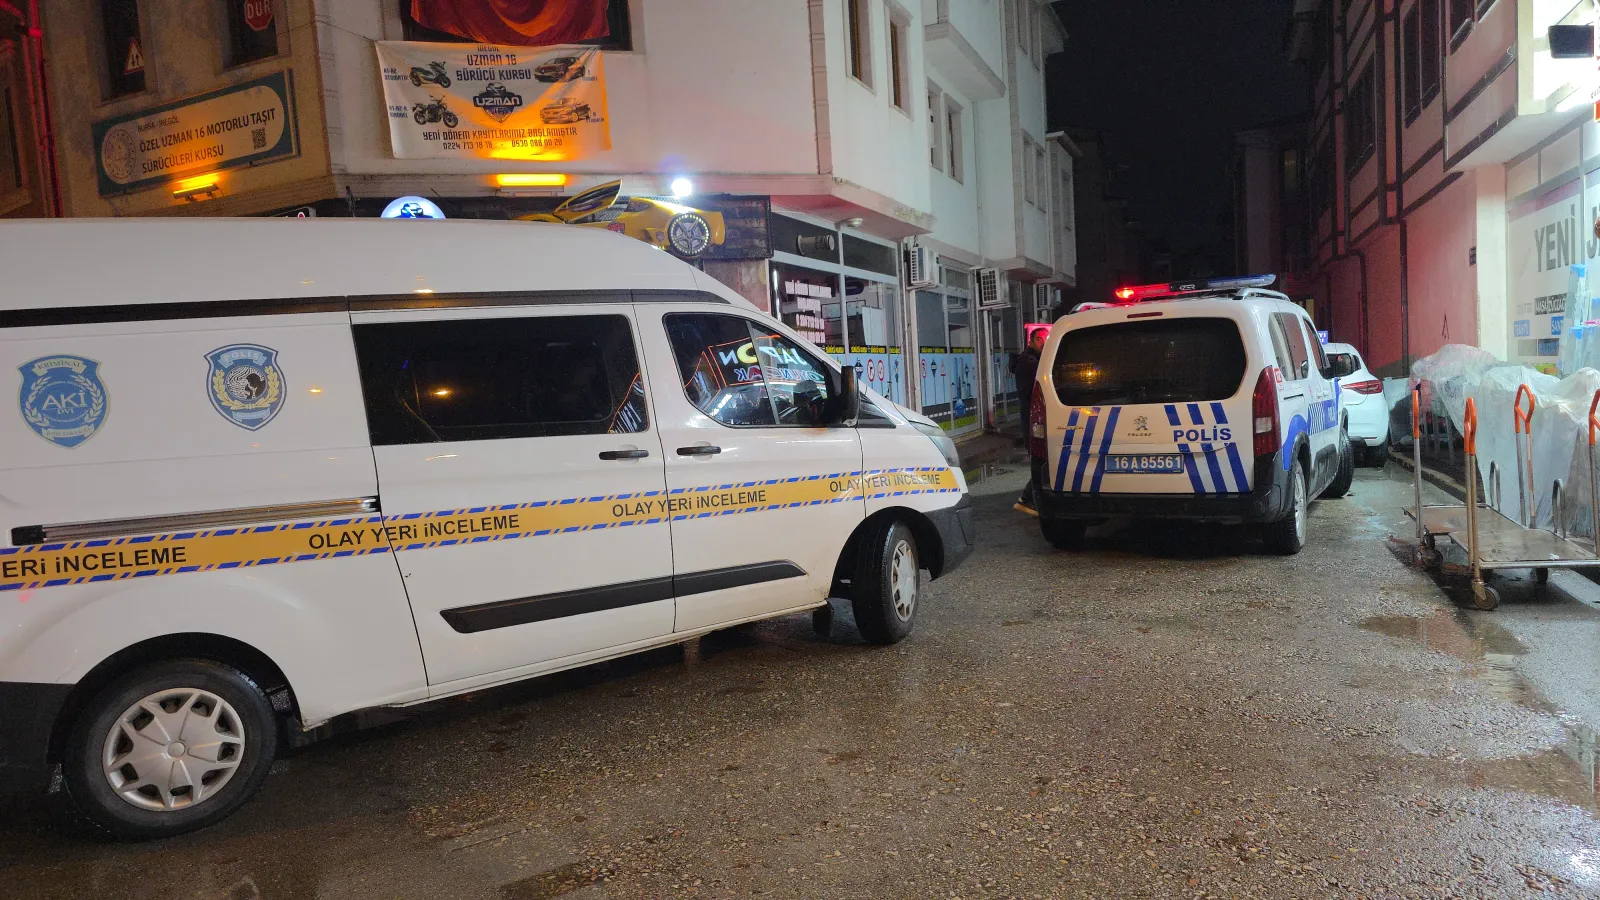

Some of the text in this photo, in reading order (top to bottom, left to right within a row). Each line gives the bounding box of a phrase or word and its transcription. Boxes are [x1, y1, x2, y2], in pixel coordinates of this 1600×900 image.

[246, 1, 271, 19] DUR
[466, 54, 517, 66] UZMAN 16
[456, 68, 531, 81] SÜRÜCÜ KURSU
[475, 96, 520, 106] UZMAN
[139, 108, 276, 153] ÖZEL UZMAN 16 MOTORLU TAŞIT
[422, 130, 441, 141] YENİ
[442, 129, 470, 141] DÖNEM
[442, 141, 461, 150] 0224
[142, 144, 224, 174] SÜRÜCÜLERİ KURSU
[1534, 204, 1575, 272] YENİ
[41, 389, 88, 410] AKİ
[1173, 425, 1232, 443] POLİS
[1114, 455, 1181, 469] 16 A 85561
[829, 479, 861, 493] OLAY
[612, 500, 654, 518] OLAY
[308, 529, 365, 549] OLAY
